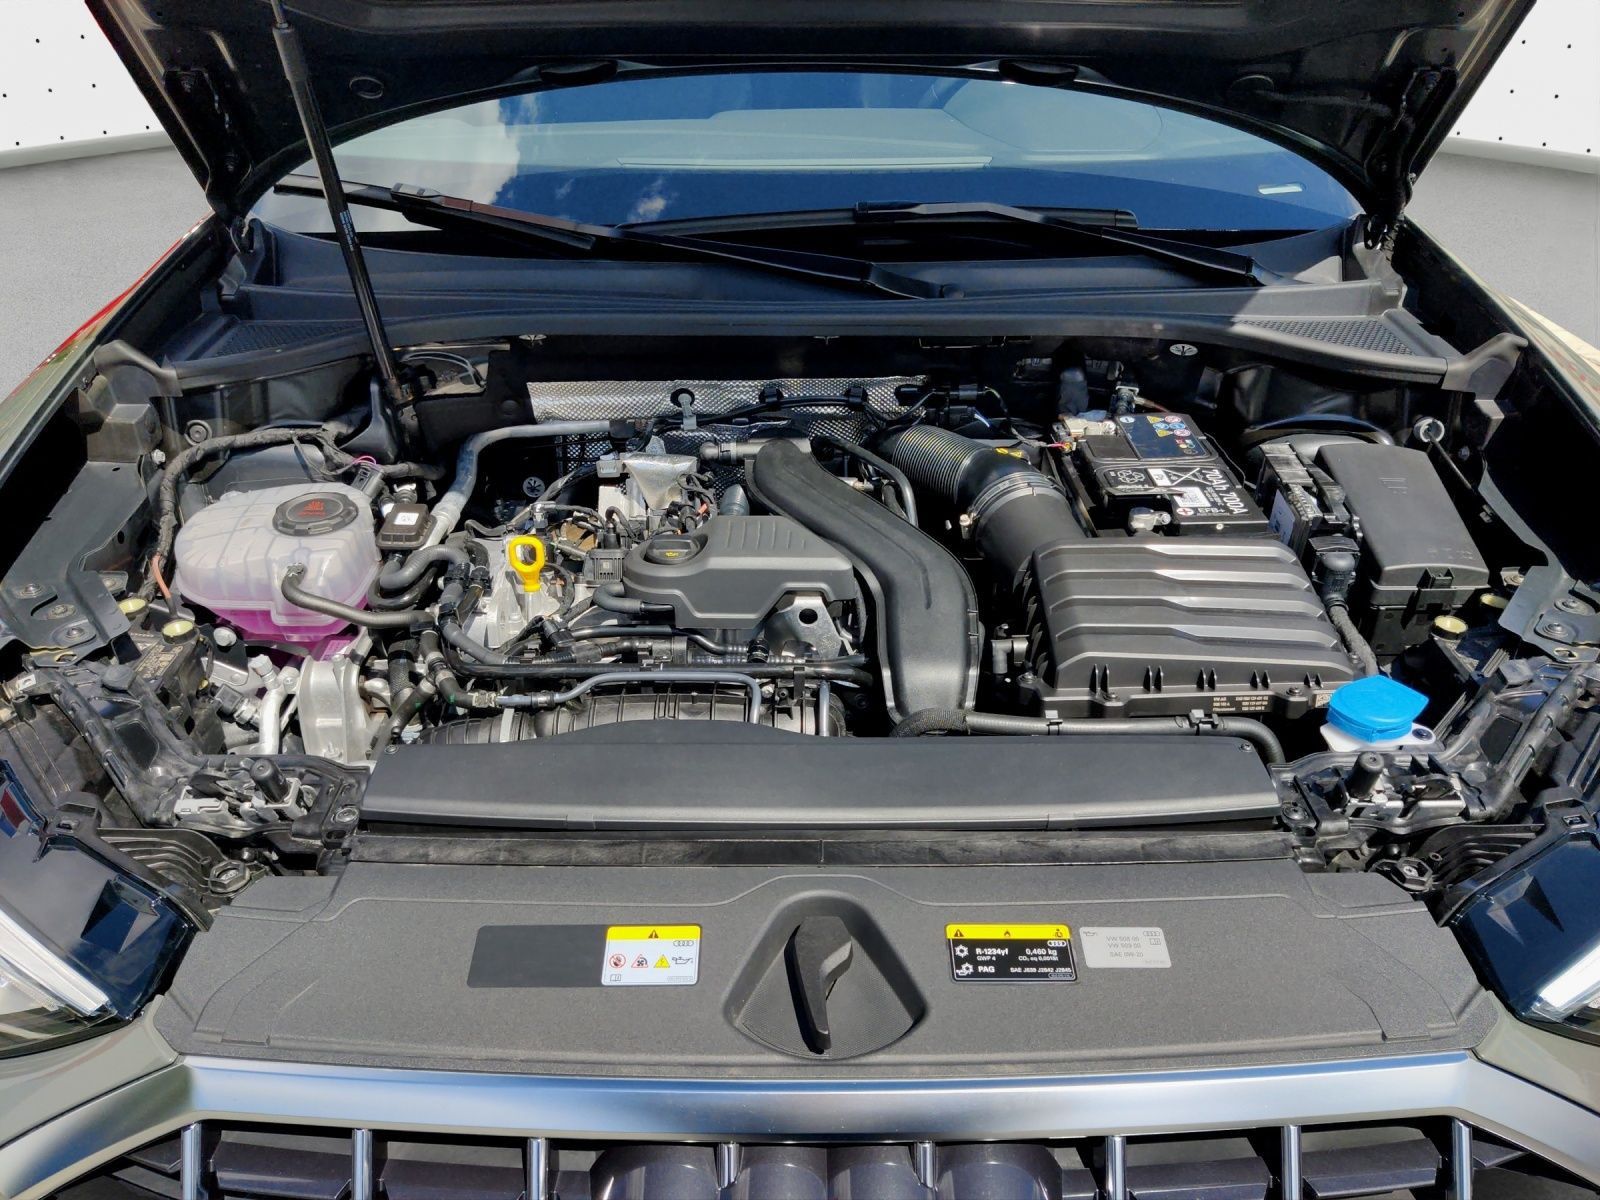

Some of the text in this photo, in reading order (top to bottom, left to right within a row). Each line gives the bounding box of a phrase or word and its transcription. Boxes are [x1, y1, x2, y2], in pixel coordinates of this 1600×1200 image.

[1202, 469, 1230, 491] 70Ah
[1219, 492, 1249, 514] 700A
[1047, 948, 1058, 956] kg
[977, 965, 996, 973] PAG
